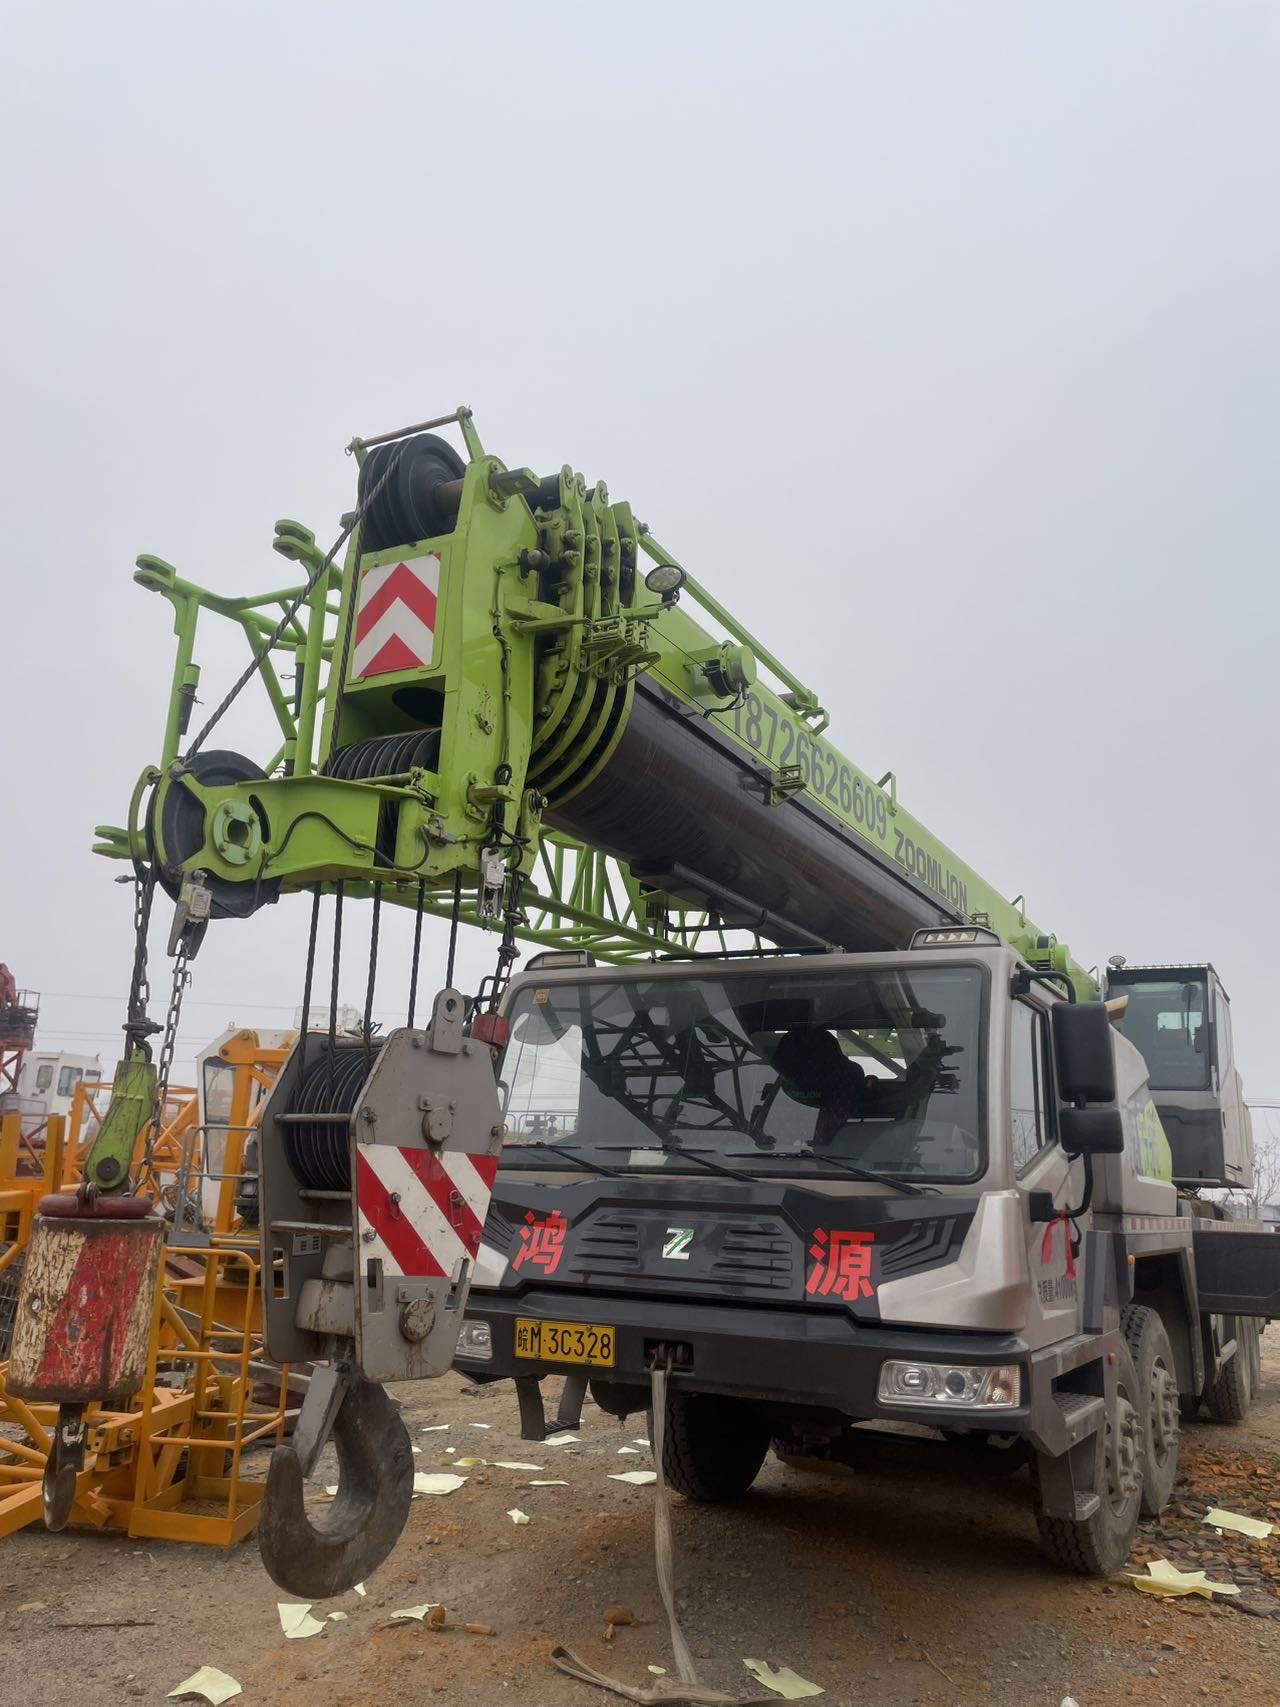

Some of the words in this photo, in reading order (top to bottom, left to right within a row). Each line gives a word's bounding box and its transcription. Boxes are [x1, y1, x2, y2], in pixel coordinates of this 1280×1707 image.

[893, 826, 968, 914] ZOOMLION
[511, 1209, 568, 1275] 鸿
[805, 1227, 875, 1301] 源
